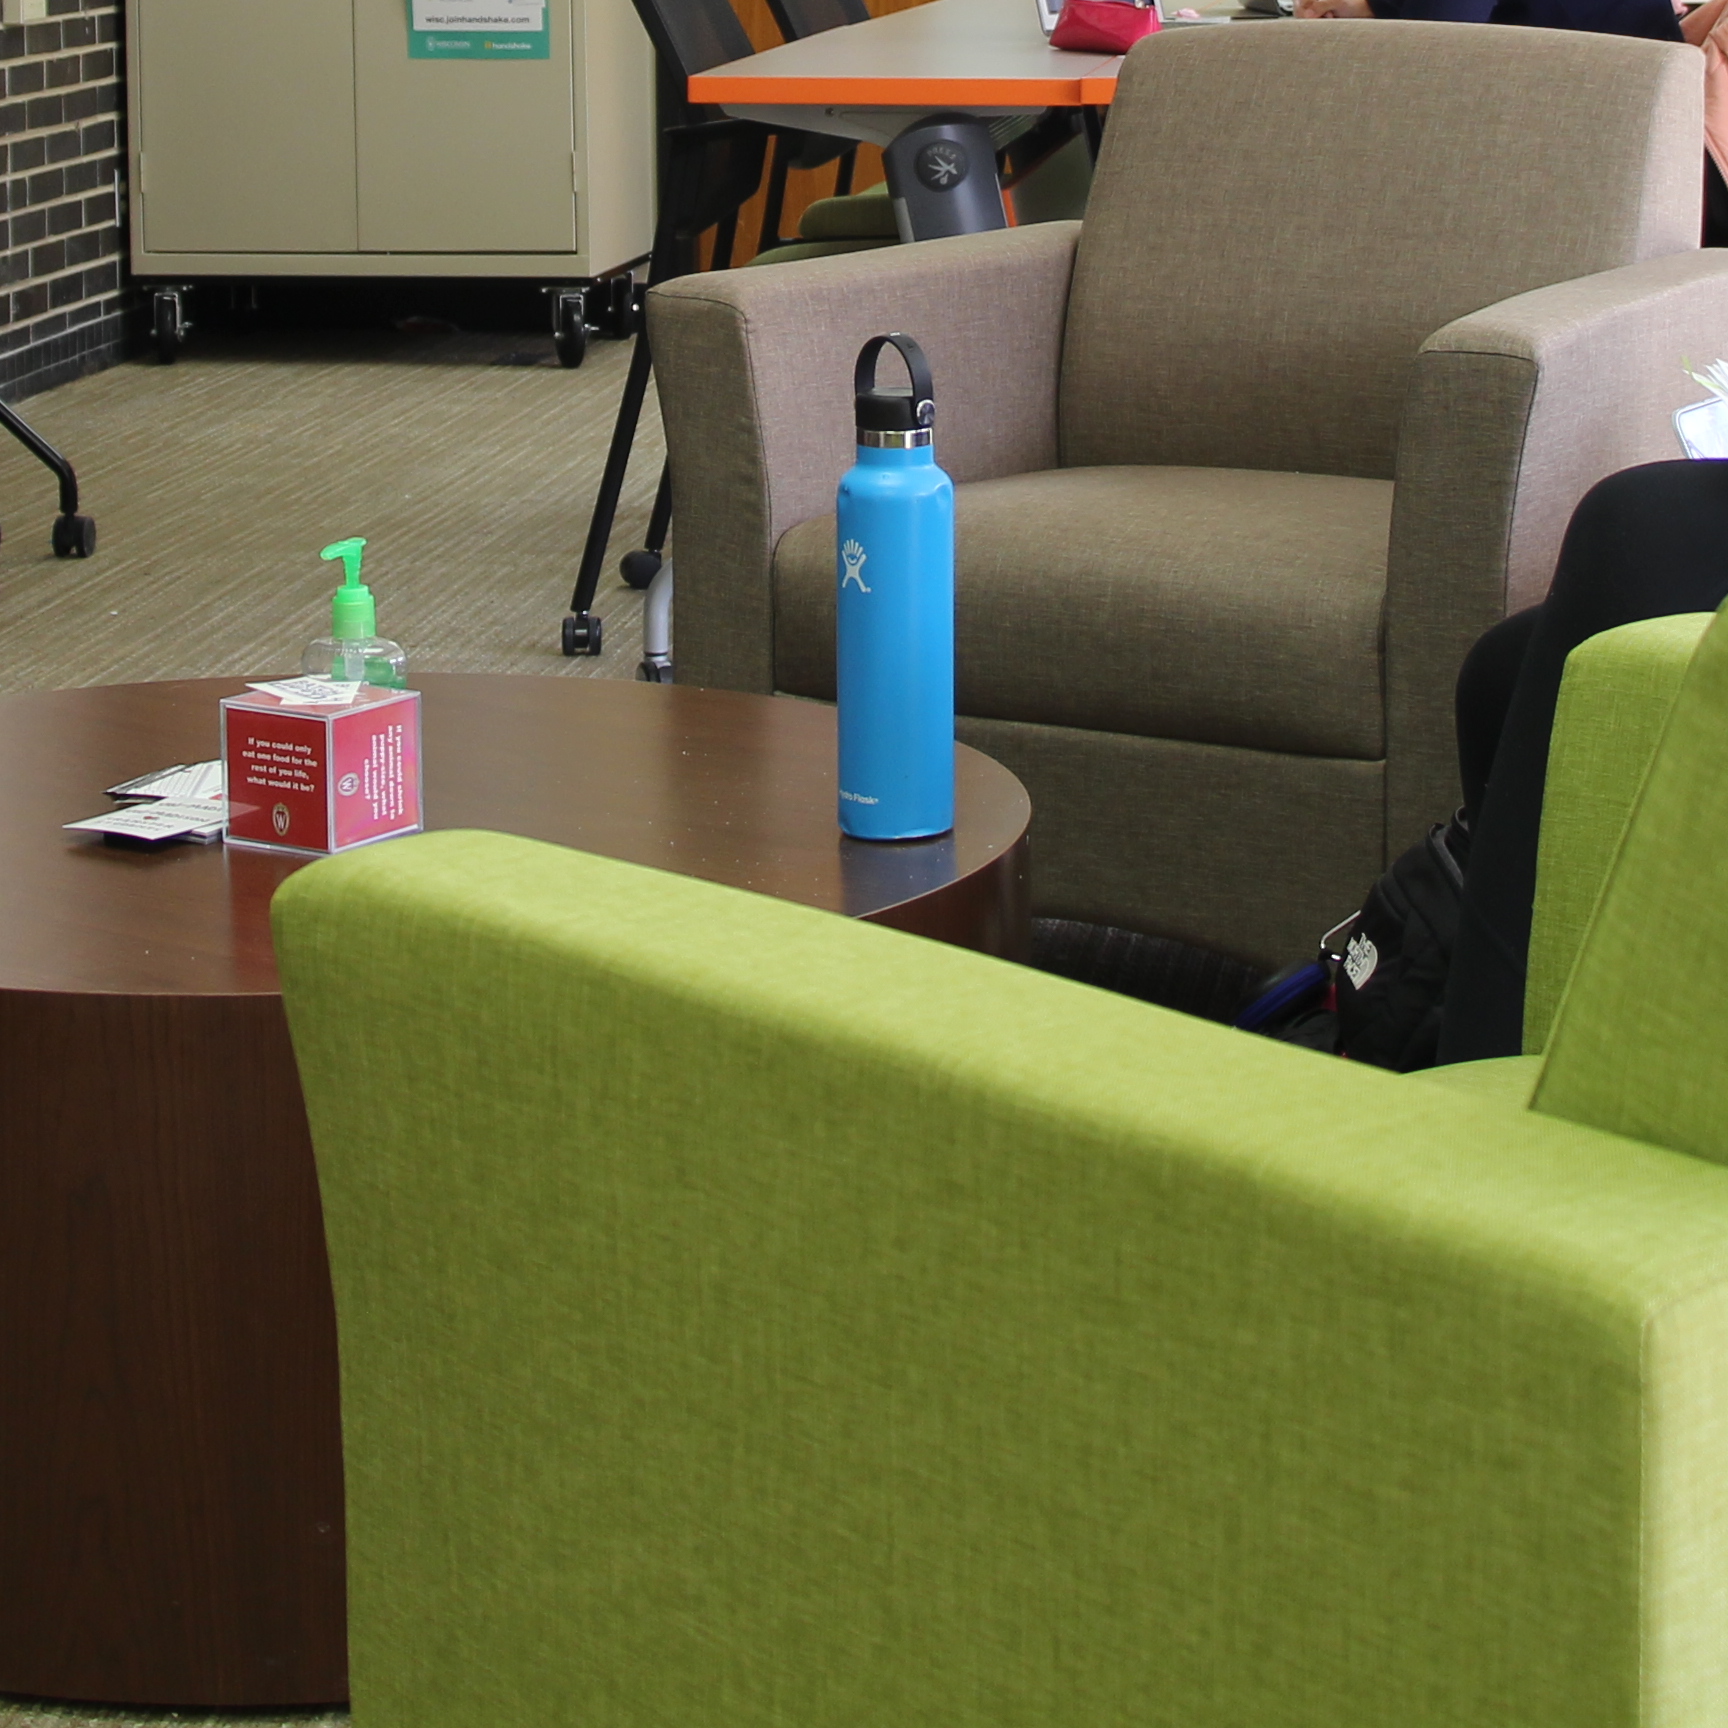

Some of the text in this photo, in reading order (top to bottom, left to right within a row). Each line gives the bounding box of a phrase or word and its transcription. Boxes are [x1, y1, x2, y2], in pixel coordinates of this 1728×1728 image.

[248, 737, 312, 756] If you could only
[242, 751, 317, 768] eat one food for the
[251, 764, 309, 780] rest of you life,
[246, 776, 315, 794] what would be?
